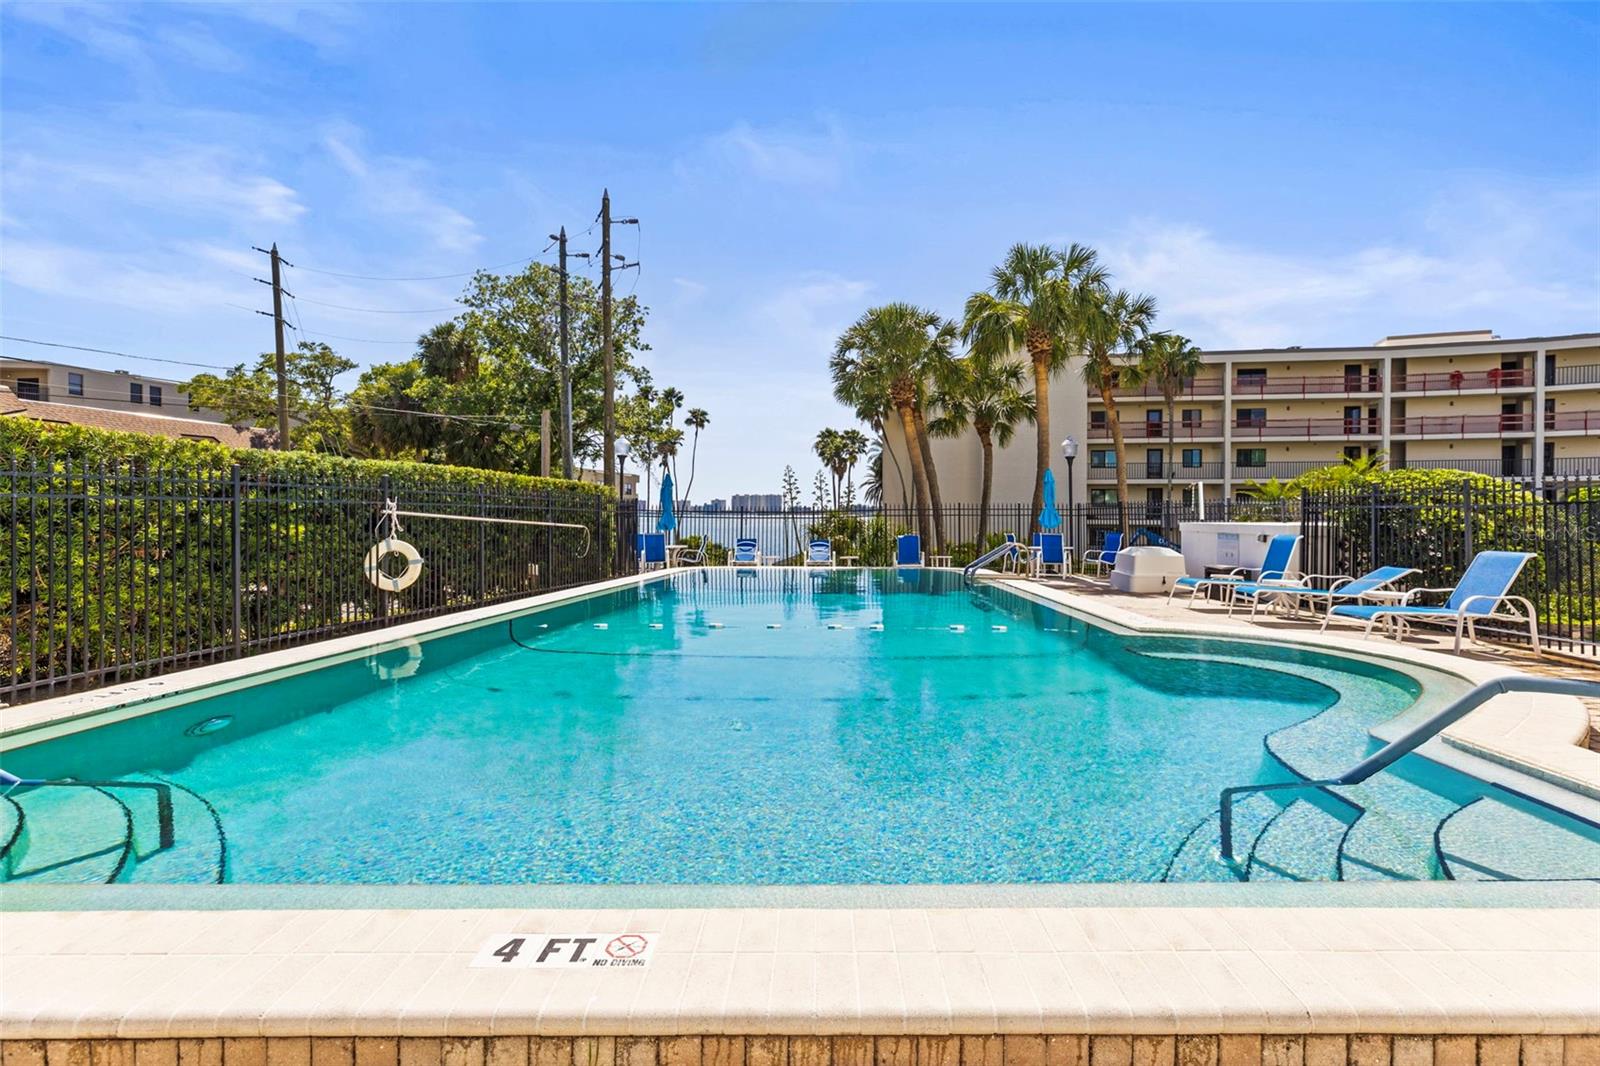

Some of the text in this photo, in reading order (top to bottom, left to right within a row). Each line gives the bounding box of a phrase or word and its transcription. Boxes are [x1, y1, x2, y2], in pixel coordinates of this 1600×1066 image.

[492, 938, 526, 962] 4
[592, 958, 647, 967] NO DIVING
